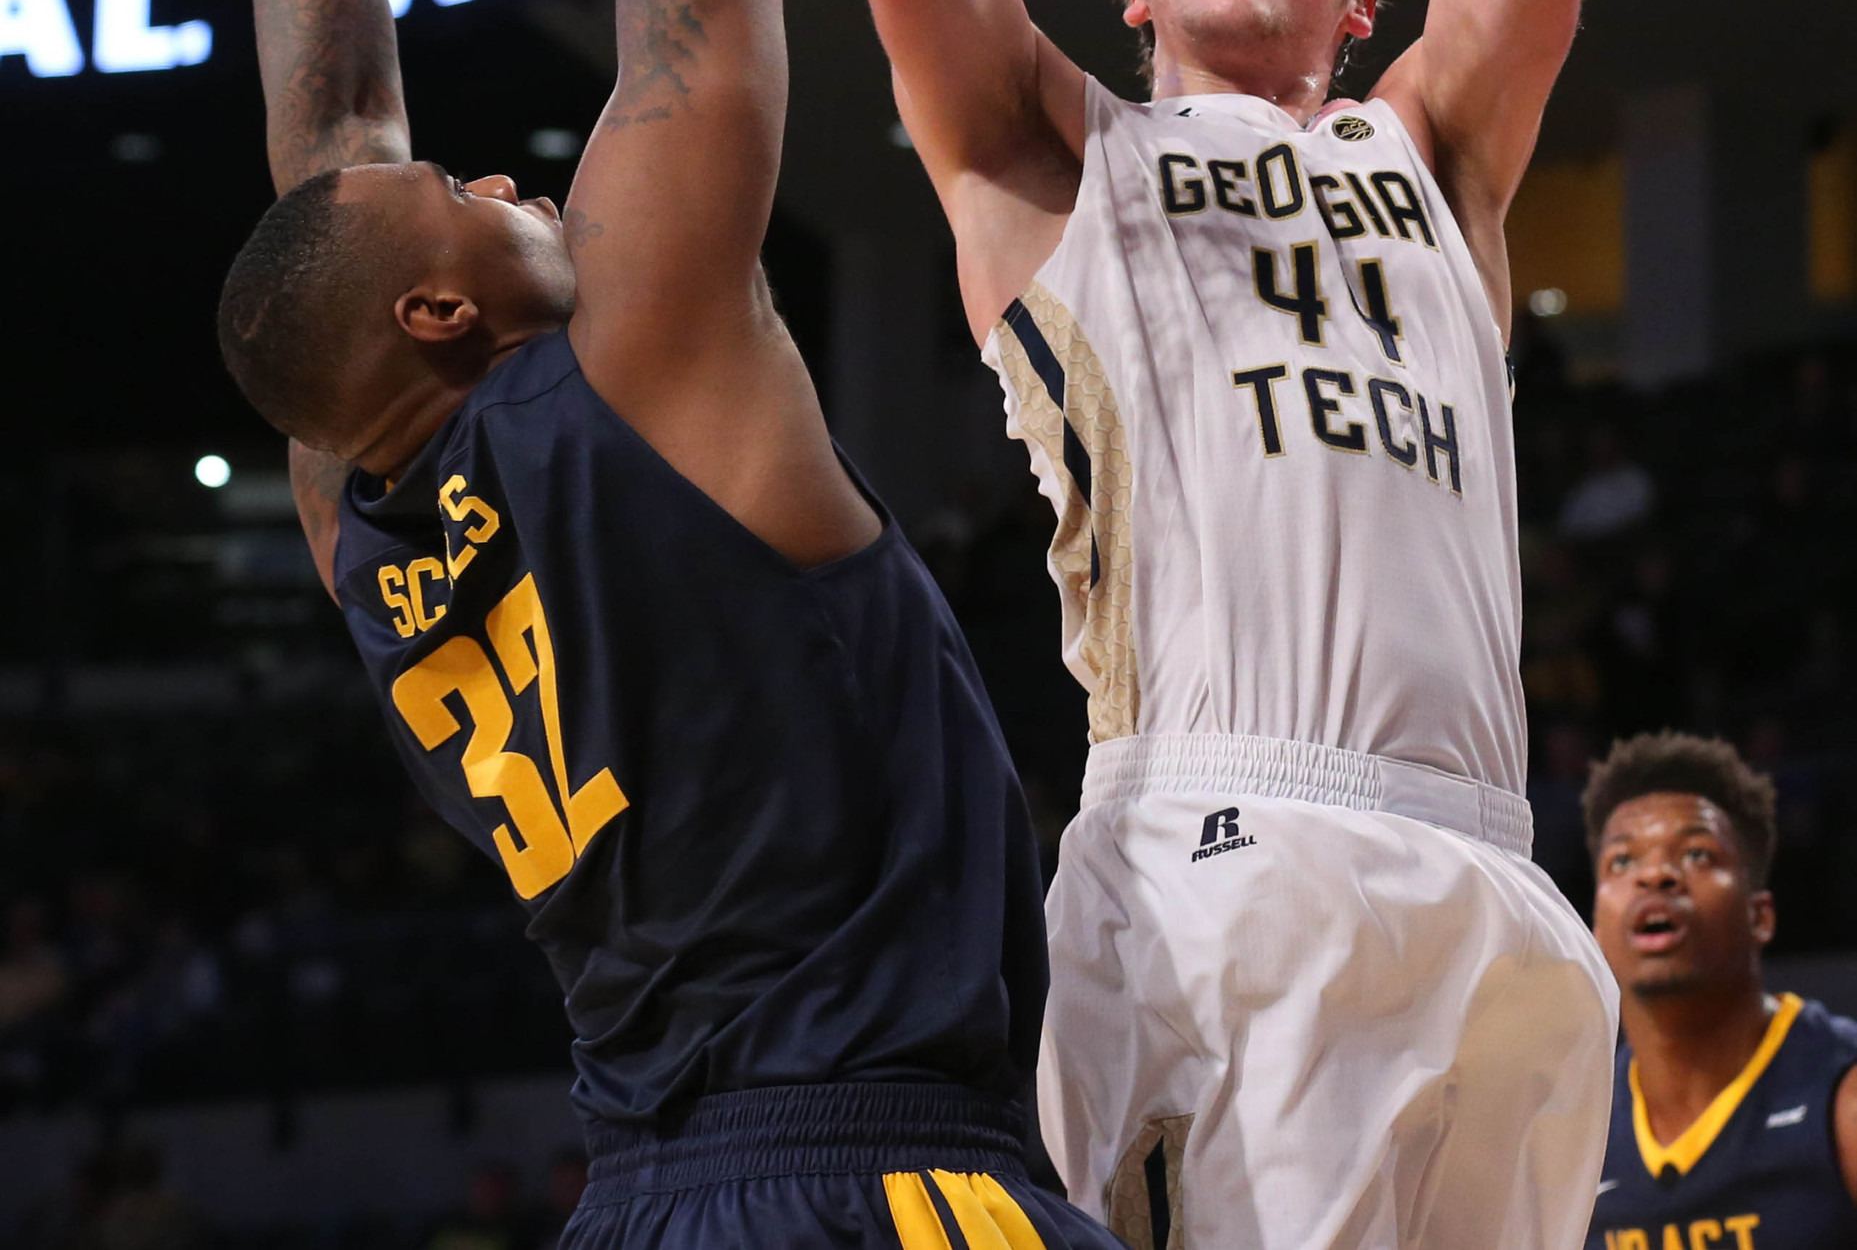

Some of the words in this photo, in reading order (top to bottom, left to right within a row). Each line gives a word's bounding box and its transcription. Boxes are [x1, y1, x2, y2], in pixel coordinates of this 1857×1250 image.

[1158, 142, 1441, 252] GEOGIA
[1231, 361, 1464, 500] TECH
[391, 571, 631, 901] 32
[1191, 835, 1258, 863] RUSSELL
